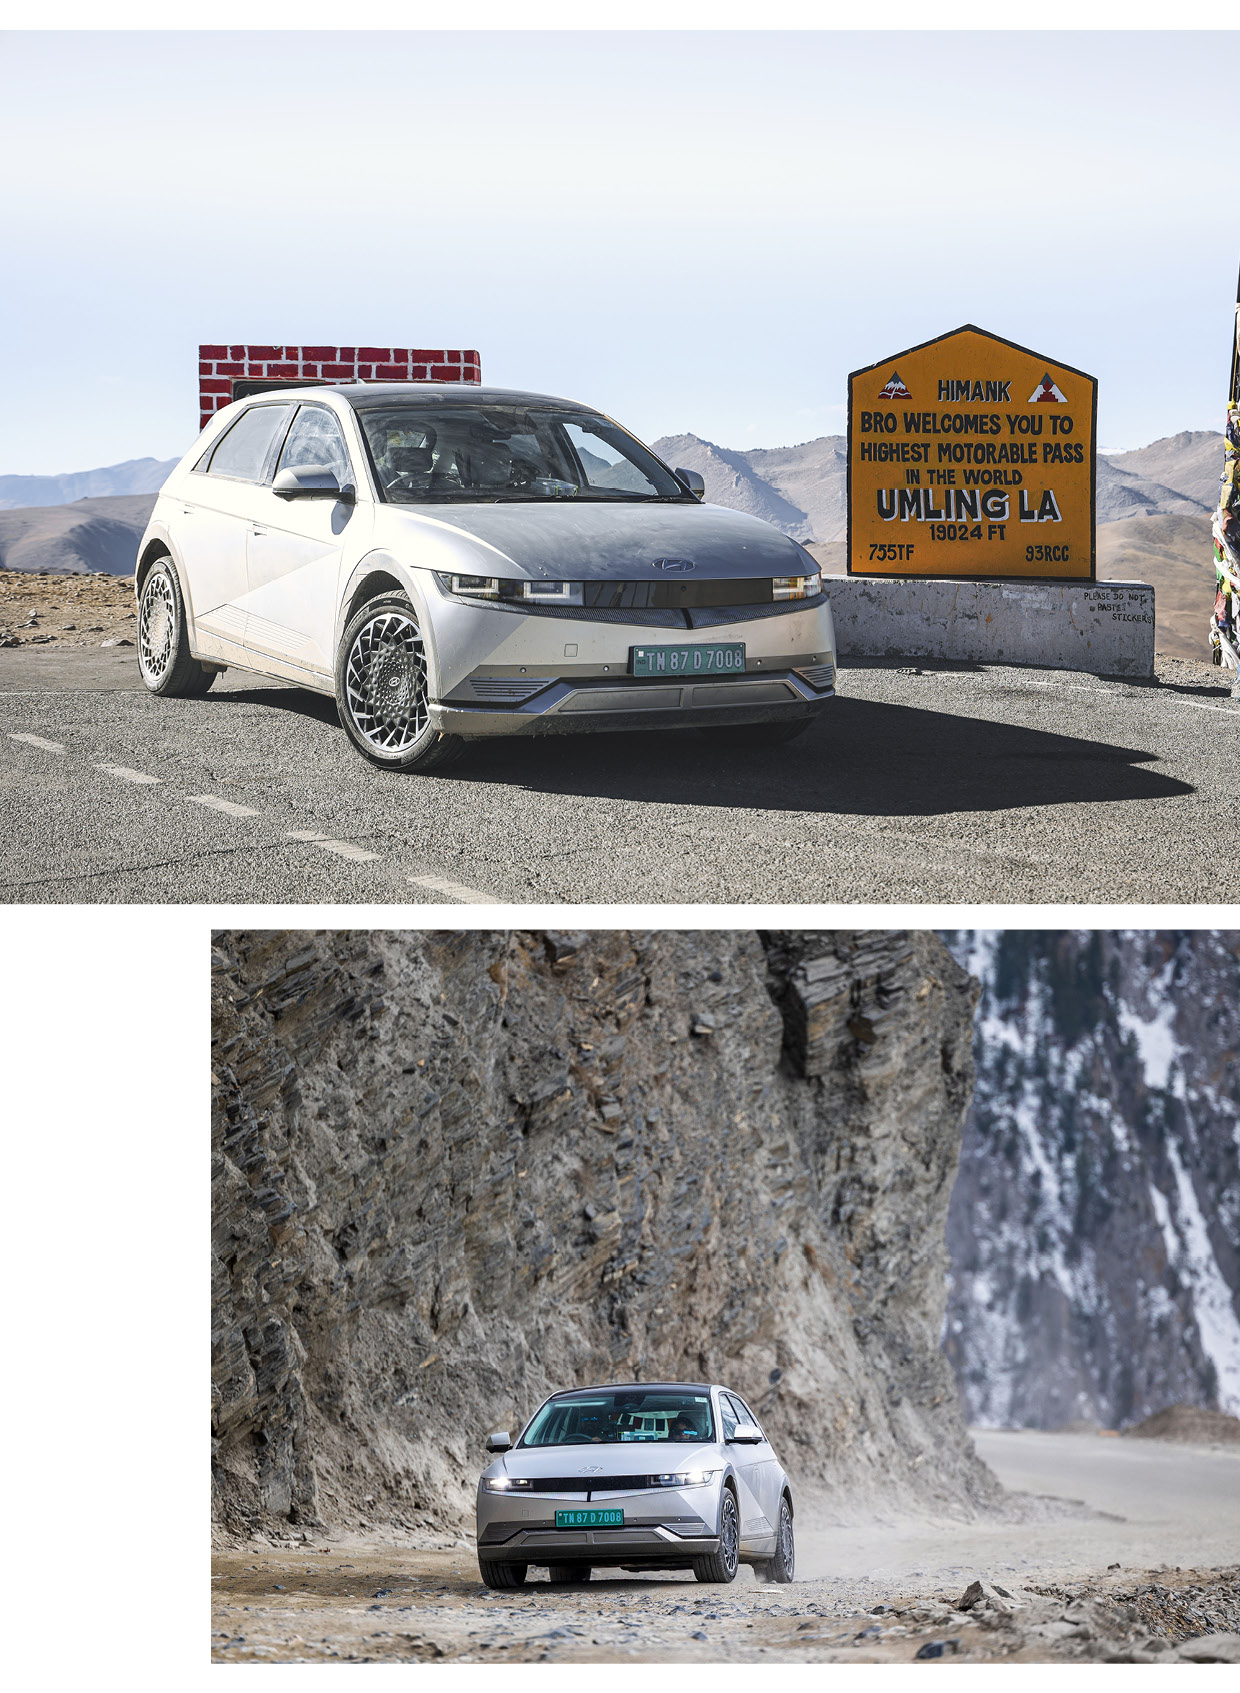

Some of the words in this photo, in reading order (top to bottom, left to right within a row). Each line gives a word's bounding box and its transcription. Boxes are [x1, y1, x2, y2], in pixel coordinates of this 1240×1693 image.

[938, 379, 1012, 402] HIMANK
[861, 411, 898, 433] BRO
[903, 412, 1002, 435] WELCOMES
[1006, 414, 1043, 435] YOU
[1048, 415, 1074, 435] TO
[860, 442, 931, 463] HIGHEST
[938, 443, 1037, 464] MOTORABLE
[1043, 443, 1084, 464] PASS
[905, 469, 920, 484] IN
[927, 469, 956, 485] THE
[963, 469, 1023, 485] WORLD
[877, 488, 1010, 522] UMLING
[1018, 489, 1062, 522] LA
[929, 524, 983, 541] 19024
[988, 524, 1006, 541] FT
[869, 543, 914, 561] 755TF
[1025, 545, 1069, 562] 93RCC
[1084, 592, 1110, 600] PLEASE
[1128, 593, 1145, 602] NOT
[1112, 613, 1152, 624] STICKERS
[647, 652, 665, 671] TN
[670, 651, 688, 670] 87
[693, 651, 702, 669] D
[706, 649, 742, 669] 7008
[563, 1512, 574, 1523] TN
[576, 1512, 588, 1523] 87
[590, 1512, 596, 1523] D
[598, 1511, 621, 1523] 7008
